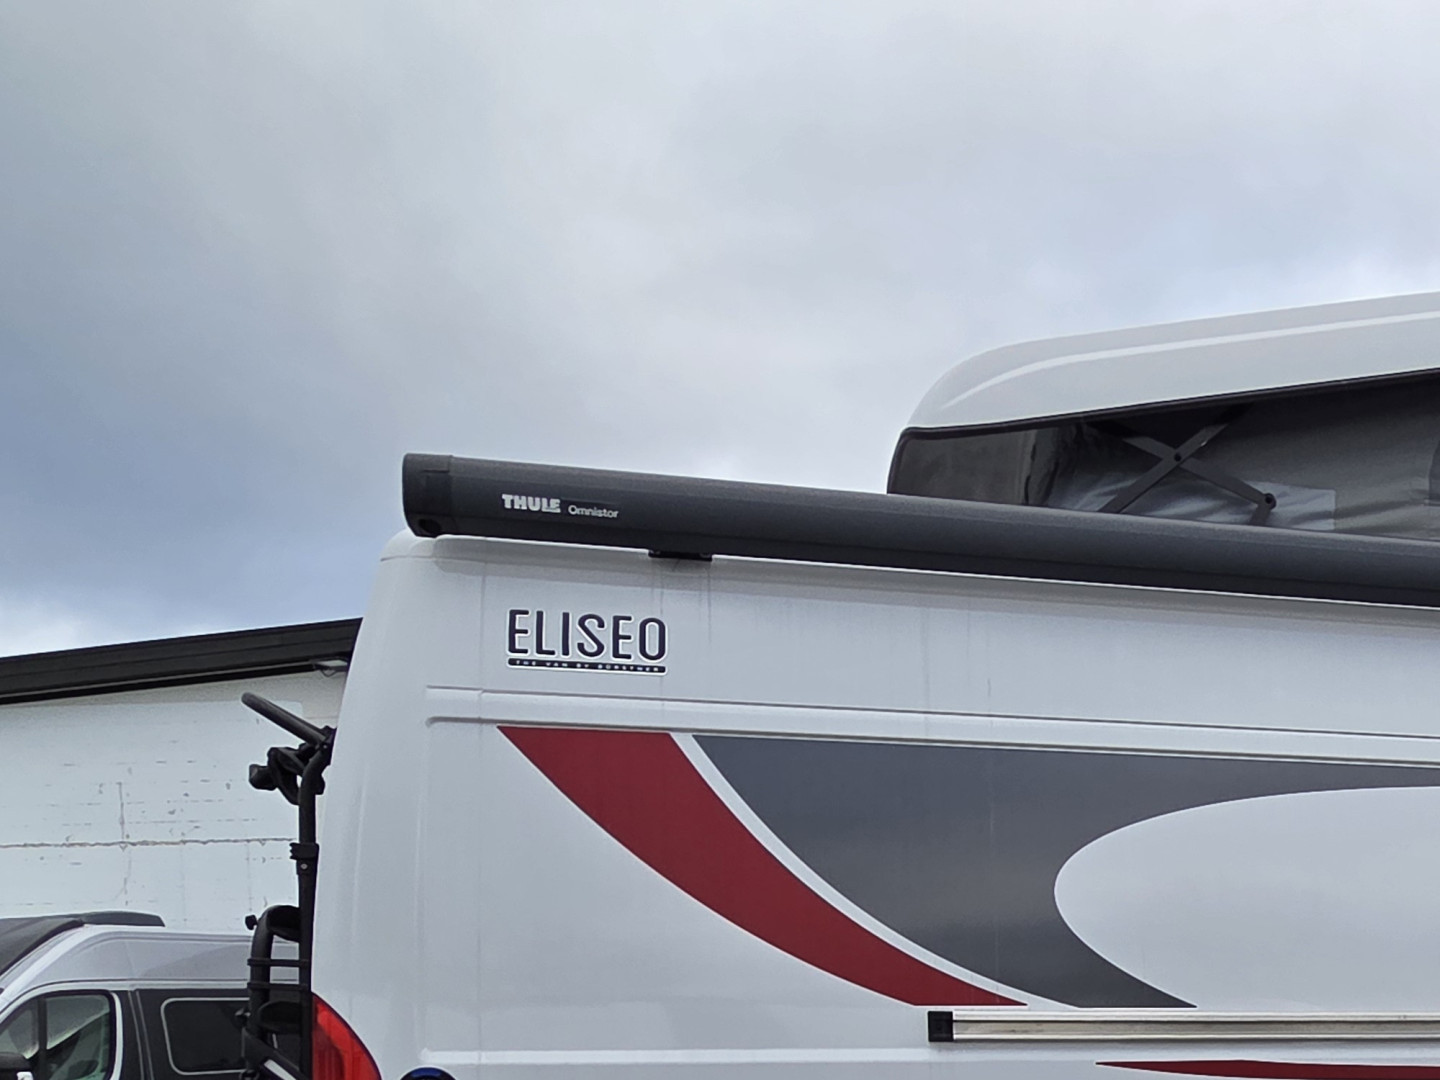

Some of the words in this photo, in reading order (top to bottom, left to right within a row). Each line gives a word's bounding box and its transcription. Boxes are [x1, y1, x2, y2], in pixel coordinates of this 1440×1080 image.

[502, 494, 561, 513] THULE
[568, 504, 619, 518] Omnistor
[508, 609, 666, 661] ELISEO
